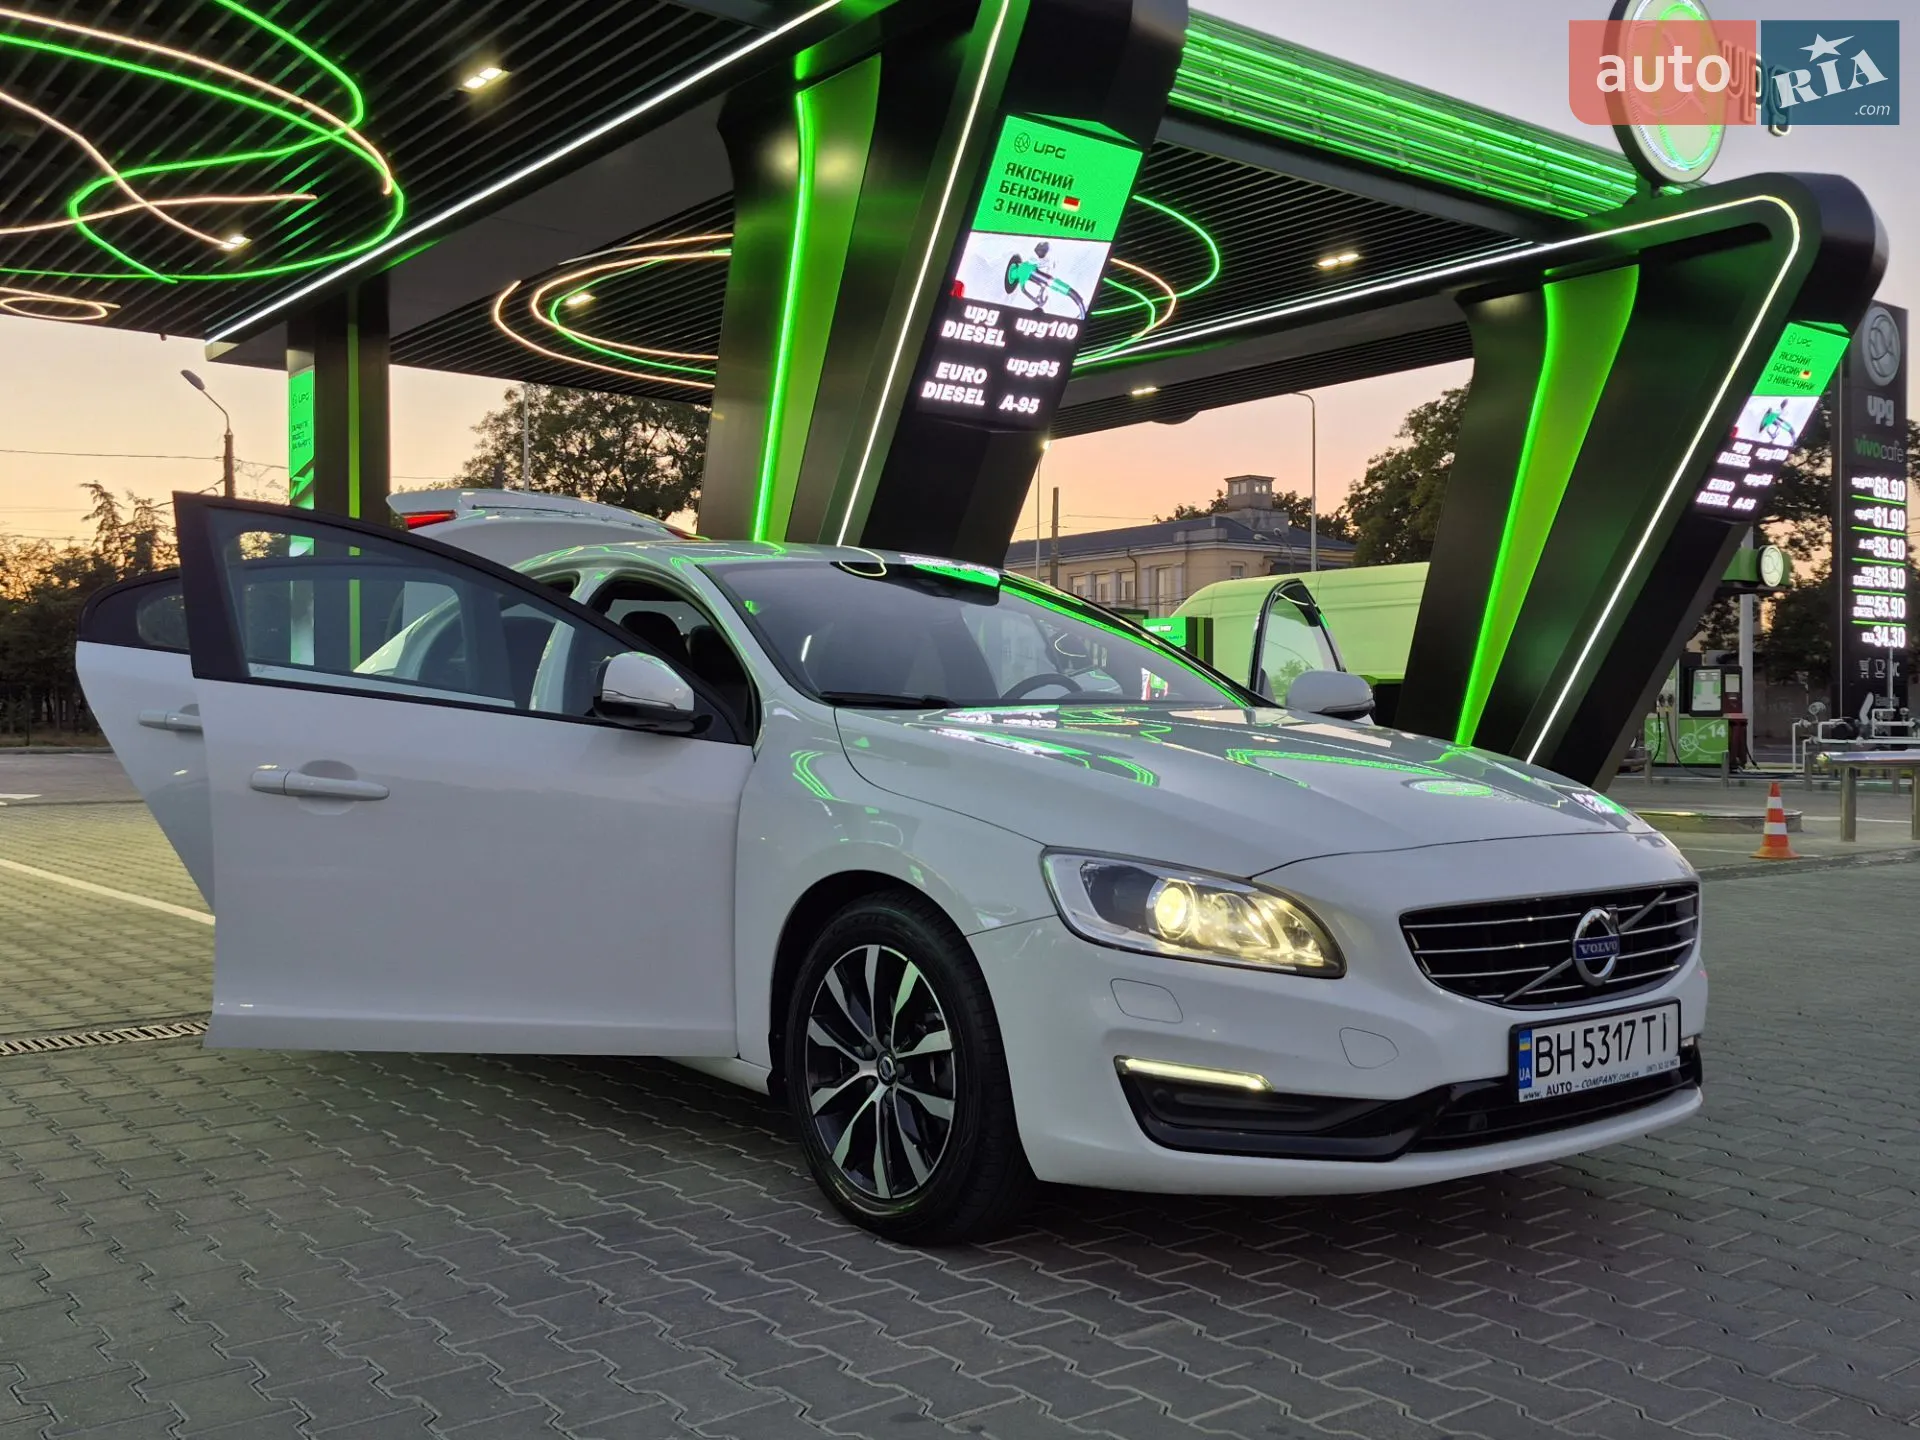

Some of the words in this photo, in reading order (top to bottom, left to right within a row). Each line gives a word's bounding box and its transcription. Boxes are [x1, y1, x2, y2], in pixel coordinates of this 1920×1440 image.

[1033, 141, 1066, 159] UPG
[1005, 162, 1074, 190] ЯКІСНИЙ
[999, 180, 1059, 205] БЕНЗИН
[994, 198, 1004, 212] З
[1006, 202, 1096, 233] НІМЕЧЧИНИ
[964, 304, 999, 327] upg
[941, 320, 1005, 347] DIESEL
[1015, 317, 1078, 340] upg100
[936, 362, 987, 384] EURO
[1006, 357, 1060, 377] upg95
[922, 381, 985, 406] DIESEL
[1000, 395, 1040, 414] A-95
[1867, 395, 1894, 427] upg
[1873, 476, 1905, 501] 68.90
[1873, 506, 1905, 531] 61.90
[1873, 536, 1905, 560] 58.90
[1874, 566, 1905, 590] 58.90
[1874, 595, 1905, 619] 55.90
[1873, 625, 1905, 648] 34.30
[1708, 724, 1726, 738] 14
[1579, 941, 1617, 954] VOLVO
[1535, 1030, 1575, 1079] BH
[1582, 1019, 1636, 1069] 5317
[1519, 1067, 1531, 1081] UA
[1546, 1081, 1572, 1096] AUTO
